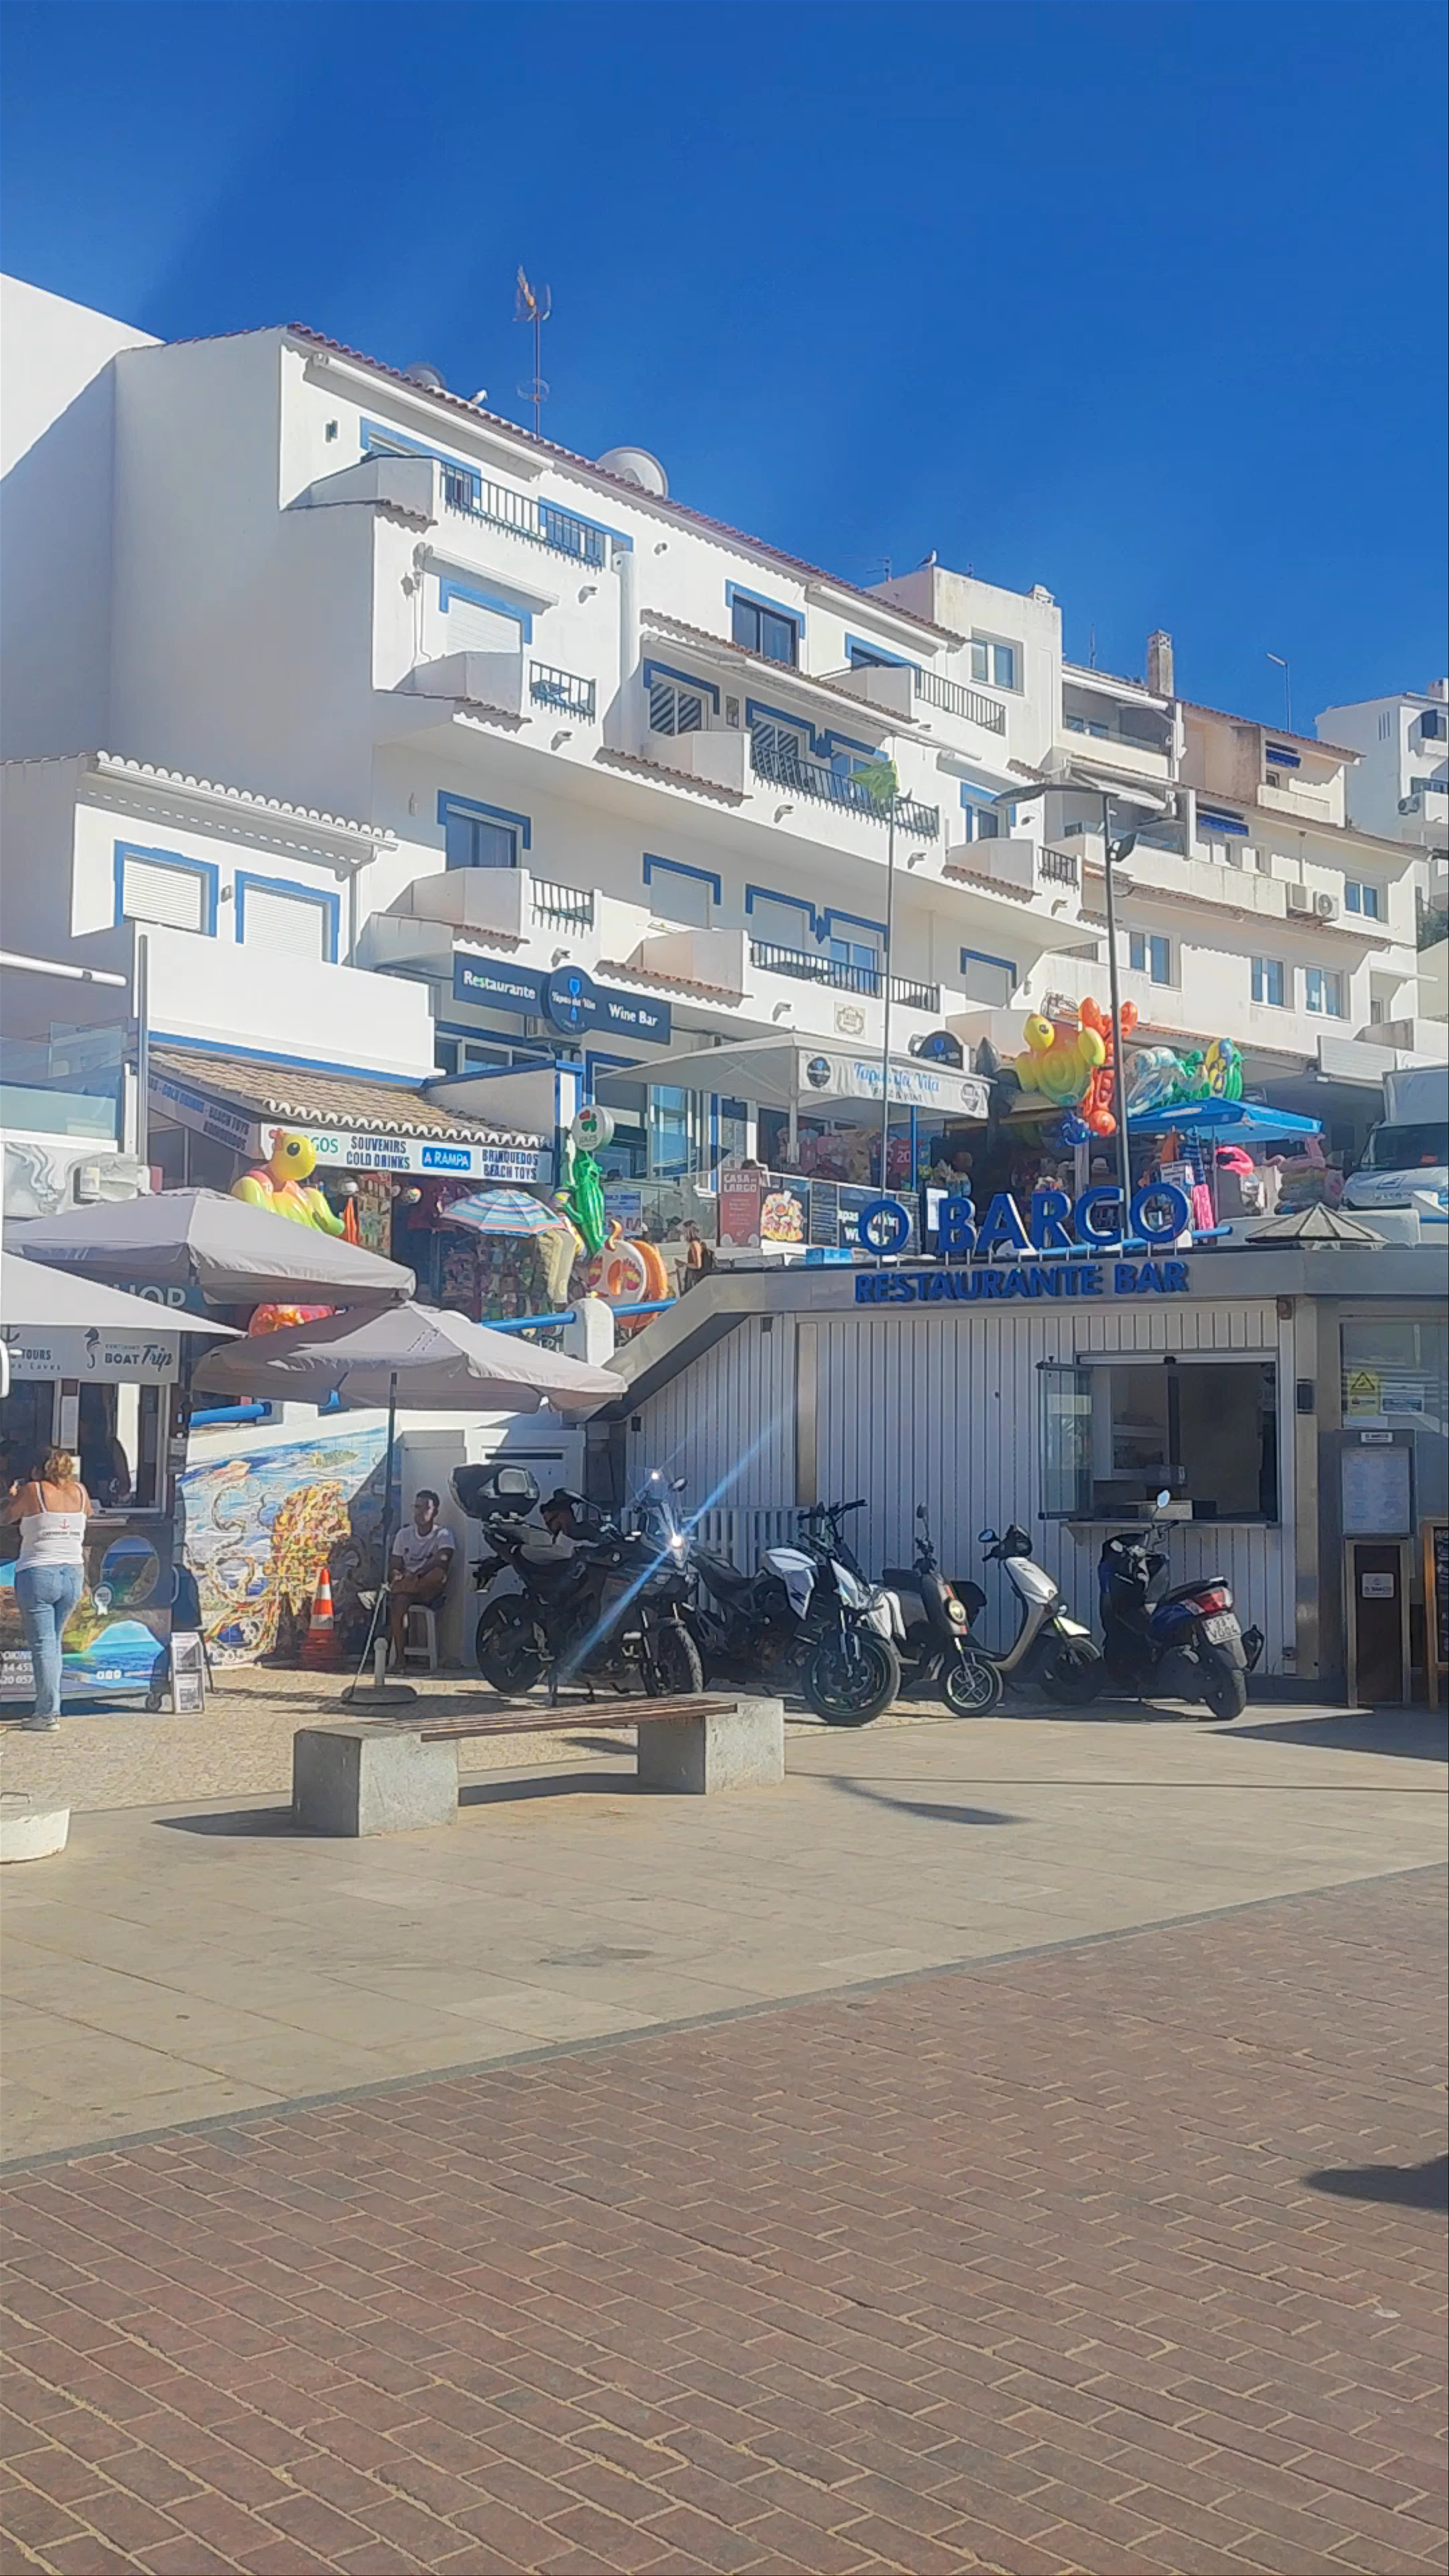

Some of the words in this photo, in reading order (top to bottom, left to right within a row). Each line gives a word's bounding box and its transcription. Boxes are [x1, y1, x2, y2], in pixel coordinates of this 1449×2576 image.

[463, 970, 536, 1000] Restaurante
[608, 1003, 636, 1022] Wine
[639, 1010, 658, 1027] Bar
[351, 1135, 406, 1153] SOUVENIRS
[346, 1150, 372, 1166] COLD
[374, 1153, 410, 1170] DRINKS
[424, 1152, 432, 1164] A
[434, 1151, 469, 1167] RAMPA
[482, 1149, 539, 1166] BRINQUEDOS
[483, 1163, 512, 1178] BEACH
[514, 1166, 537, 1180] TOYS
[724, 1174, 750, 1183] CASA
[724, 1183, 757, 1192] LARGO
[858, 1199, 913, 1255] O
[938, 1183, 1192, 1253] BARCO
[855, 1264, 1103, 1303] RESTAURANTE
[1114, 1261, 1189, 1293] BAR
[22, 1349, 51, 1360] TOURS
[105, 1352, 140, 1365] BOAT
[142, 1344, 173, 1372] Trip
